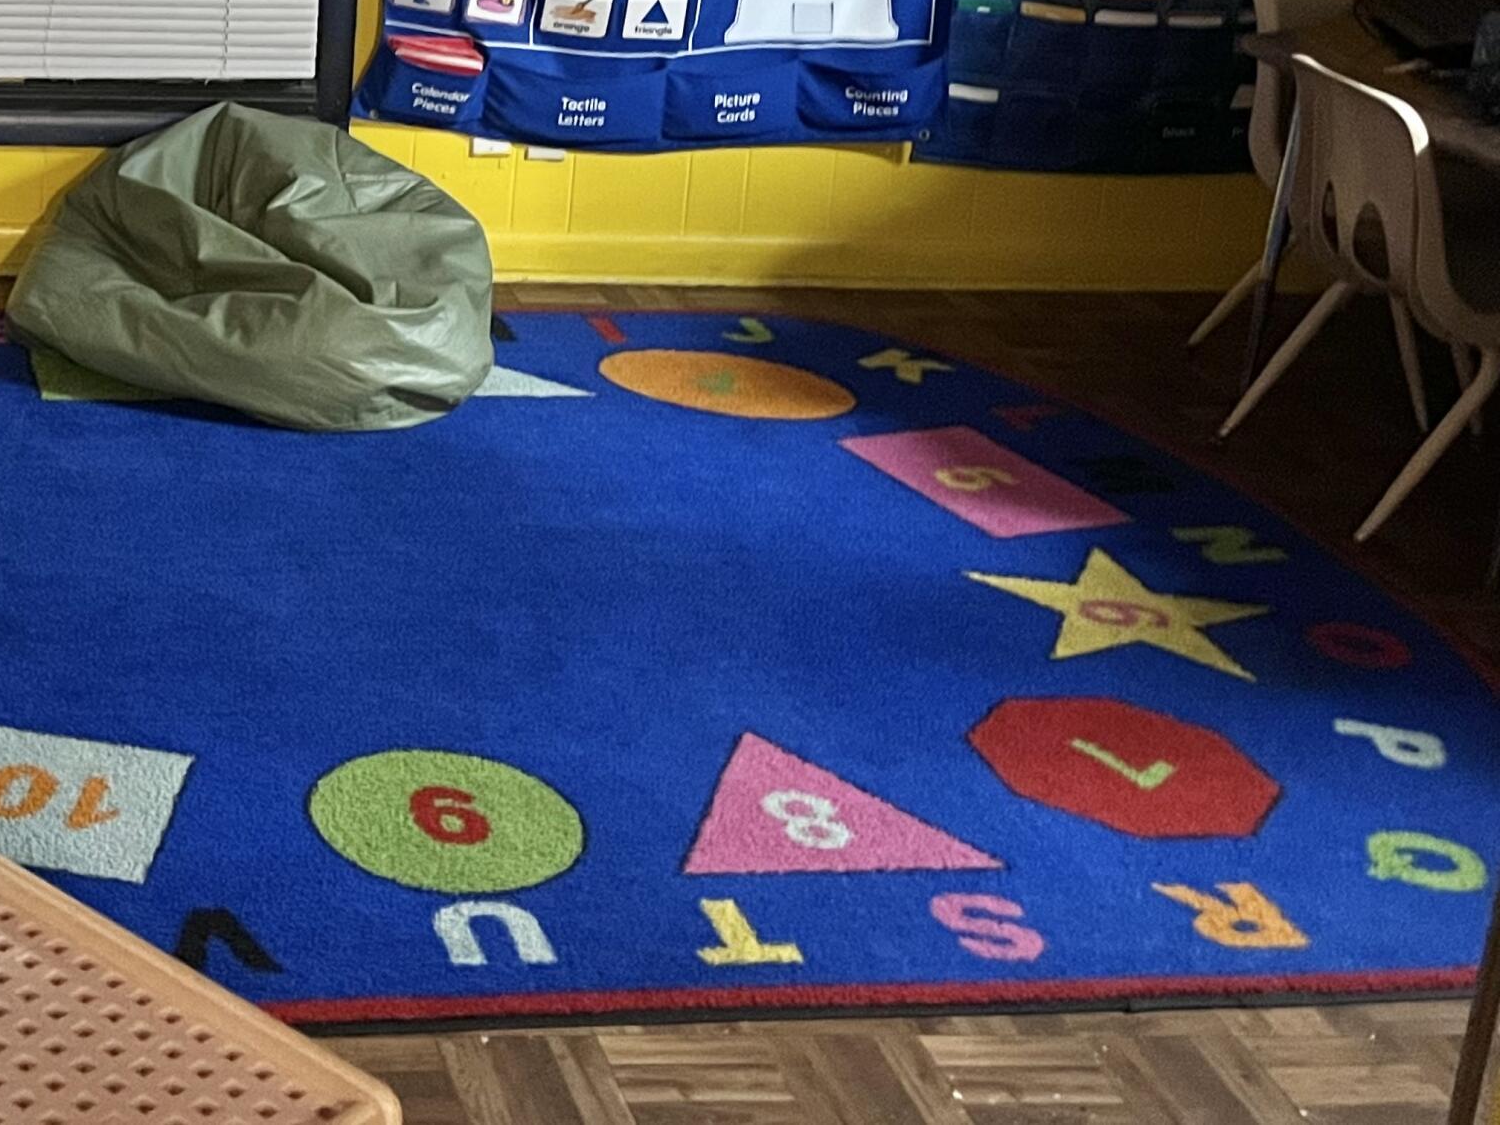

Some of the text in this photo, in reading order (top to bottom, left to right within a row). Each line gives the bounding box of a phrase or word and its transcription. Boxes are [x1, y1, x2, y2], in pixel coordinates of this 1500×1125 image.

[552, 20, 591, 34] orange
[633, 24, 674, 37] triangle
[411, 81, 471, 104] Calendar
[713, 92, 762, 110] Picture
[844, 85, 909, 105] Counting
[412, 97, 457, 116] Pieces
[560, 96, 608, 113] Tactile
[853, 101, 900, 117] Pieces
[557, 112, 606, 128] Letters
[716, 108, 756, 124] Cards
[857, 348, 957, 384] K
[1332, 717, 1447, 770] P
[761, 788, 853, 851] 8
[1366, 828, 1488, 892] Q
[1150, 880, 1311, 949] R
[432, 900, 559, 966] U
[695, 897, 805, 967] T
[928, 892, 1047, 964] S
